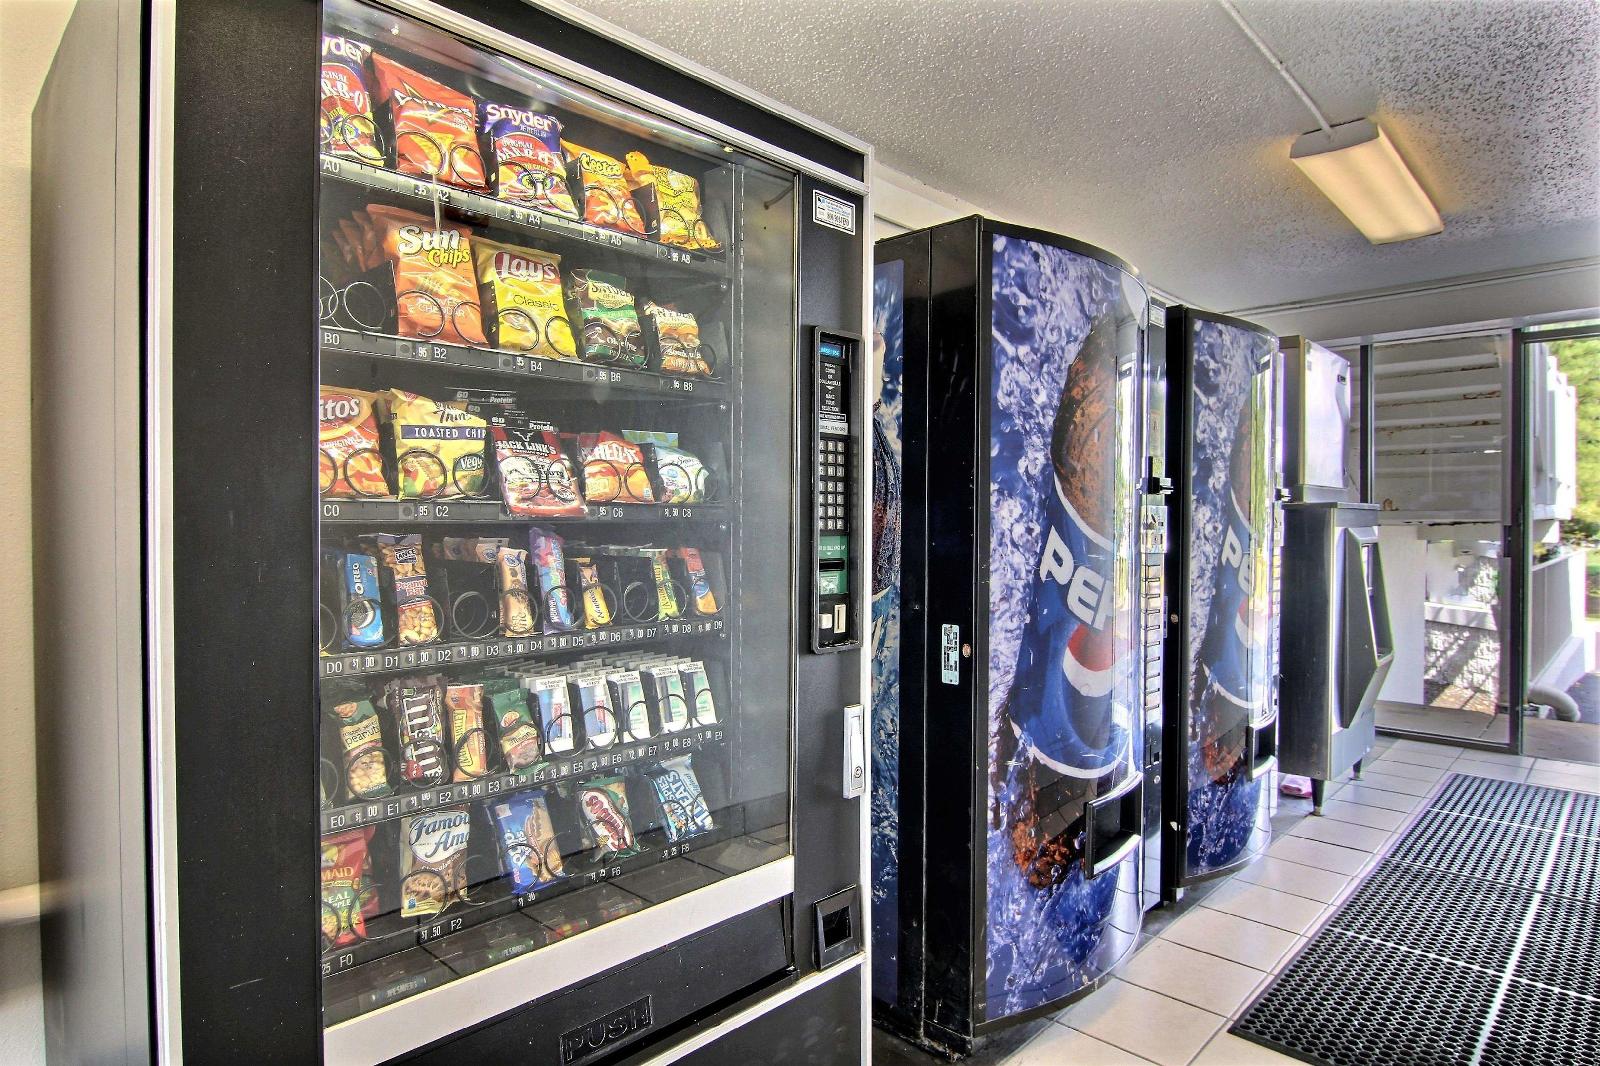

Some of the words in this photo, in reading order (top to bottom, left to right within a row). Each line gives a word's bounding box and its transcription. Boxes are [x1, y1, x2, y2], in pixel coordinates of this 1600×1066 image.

[321, 35, 371, 65] yder
[323, 159, 340, 174] A0
[436, 186, 450, 201] A2
[528, 214, 541, 225] A4
[399, 224, 461, 256] Sun
[610, 235, 622, 246] A6
[427, 246, 471, 268] Chips
[680, 253, 691, 264] A8
[513, 294, 560, 312] Classic
[324, 332, 340, 345] B0
[434, 347, 447, 359] B2
[530, 360, 543, 372] B4
[610, 372, 621, 382] B6
[683, 381, 693, 391] B8
[319, 397, 360, 421] itos
[414, 426, 459, 438] TOASTED
[465, 426, 487, 439] CHIP
[496, 439, 524, 451] JACK
[323, 504, 340, 517] C0
[435, 504, 449, 517] C2
[612, 508, 624, 518] C6
[352, 562, 364, 595] OREO
[682, 624, 692, 634] D8
[713, 620, 723, 630] D9
[610, 632, 621, 642] D6
[646, 628, 657, 638] D7
[530, 640, 542, 651] D4
[572, 636, 584, 647] D5
[437, 650, 452, 661] D2
[486, 645, 499, 656] D3
[326, 661, 343, 674] D0
[385, 655, 399, 668] D1
[682, 738, 692, 748] E8
[648, 746, 658, 756] E7
[612, 754, 622, 764] E6
[573, 762, 584, 774] E5
[533, 772, 545, 783] E4
[488, 781, 500, 793] E3
[439, 792, 452, 804] E2
[387, 802, 399, 816] E1
[330, 815, 345, 828] E0
[409, 813, 470, 845] Famou
[425, 830, 470, 858] Amo
[611, 867, 621, 877] F6
[450, 918, 462, 931] F2
[339, 953, 353, 967] F0
[565, 1001, 650, 1061] PUSH
